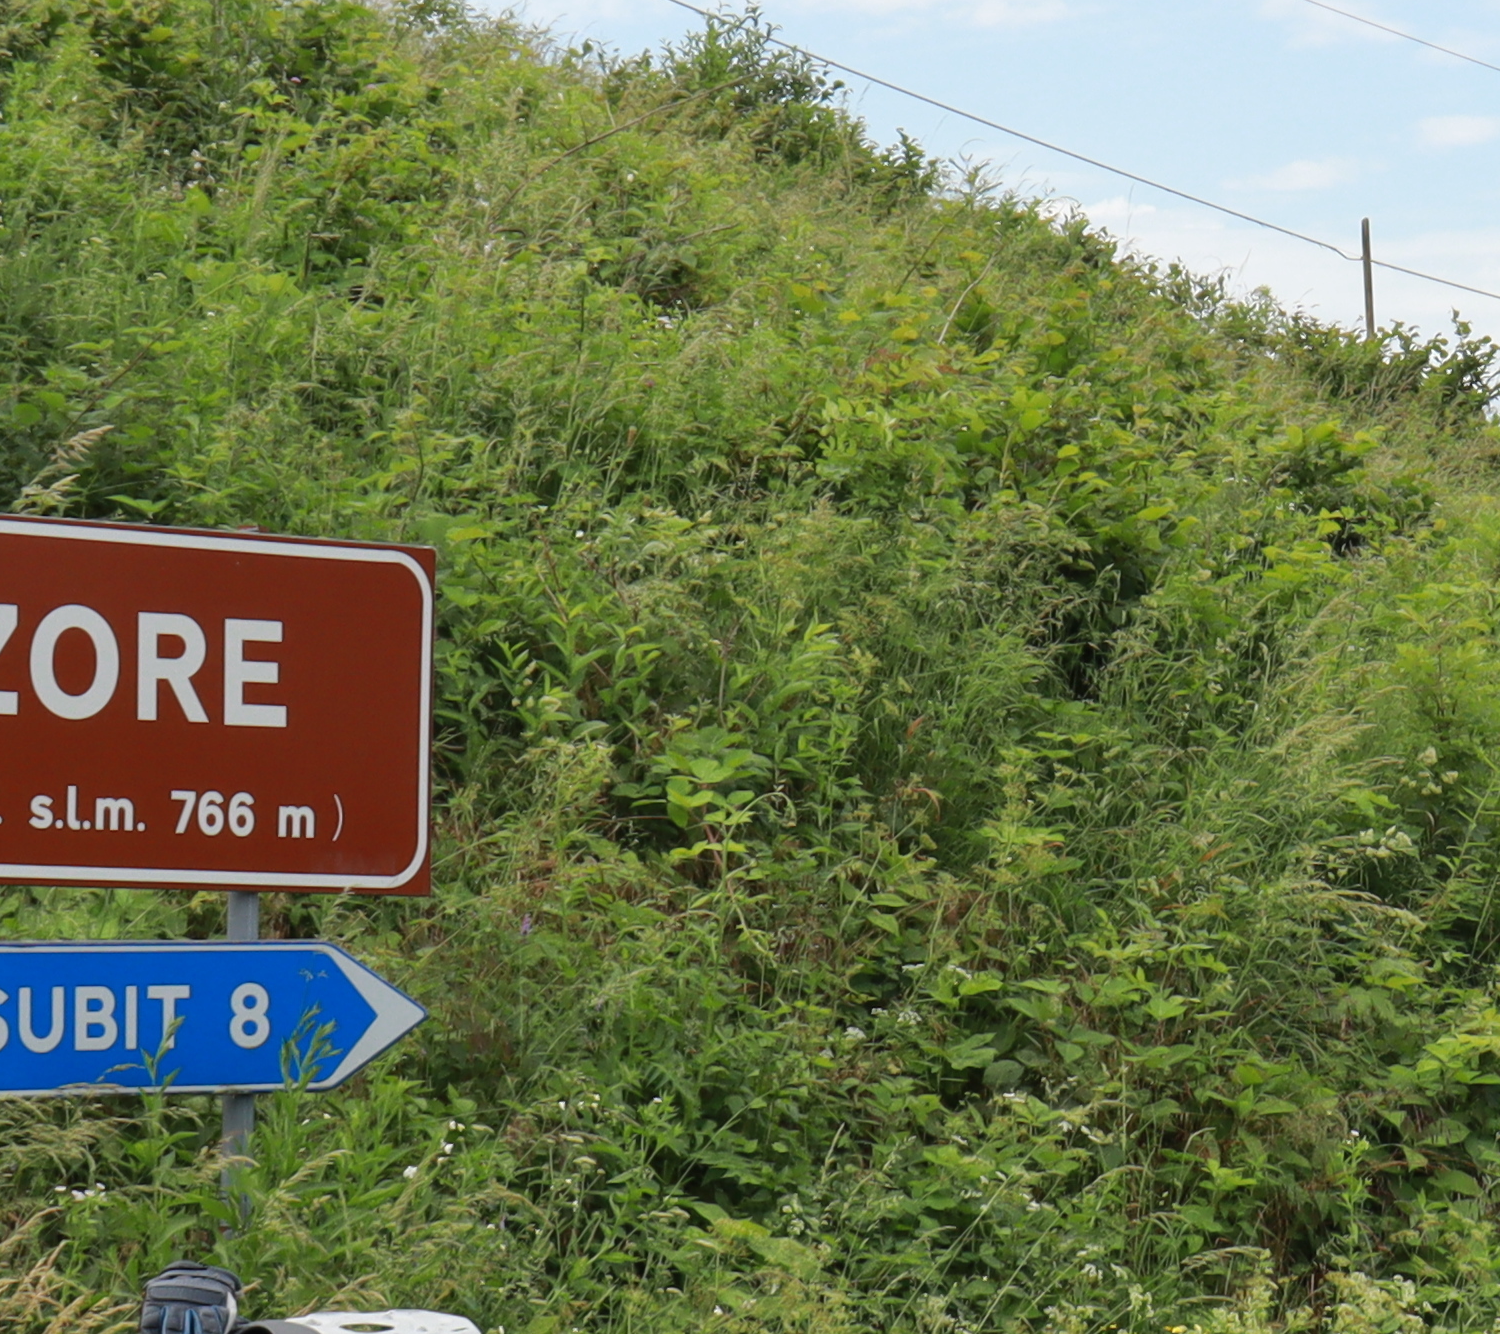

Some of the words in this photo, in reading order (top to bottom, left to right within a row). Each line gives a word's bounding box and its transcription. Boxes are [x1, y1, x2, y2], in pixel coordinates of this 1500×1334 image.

[28, 785, 146, 832] s.l.m.
[170, 790, 255, 837] 766
[229, 982, 270, 1049] 8
